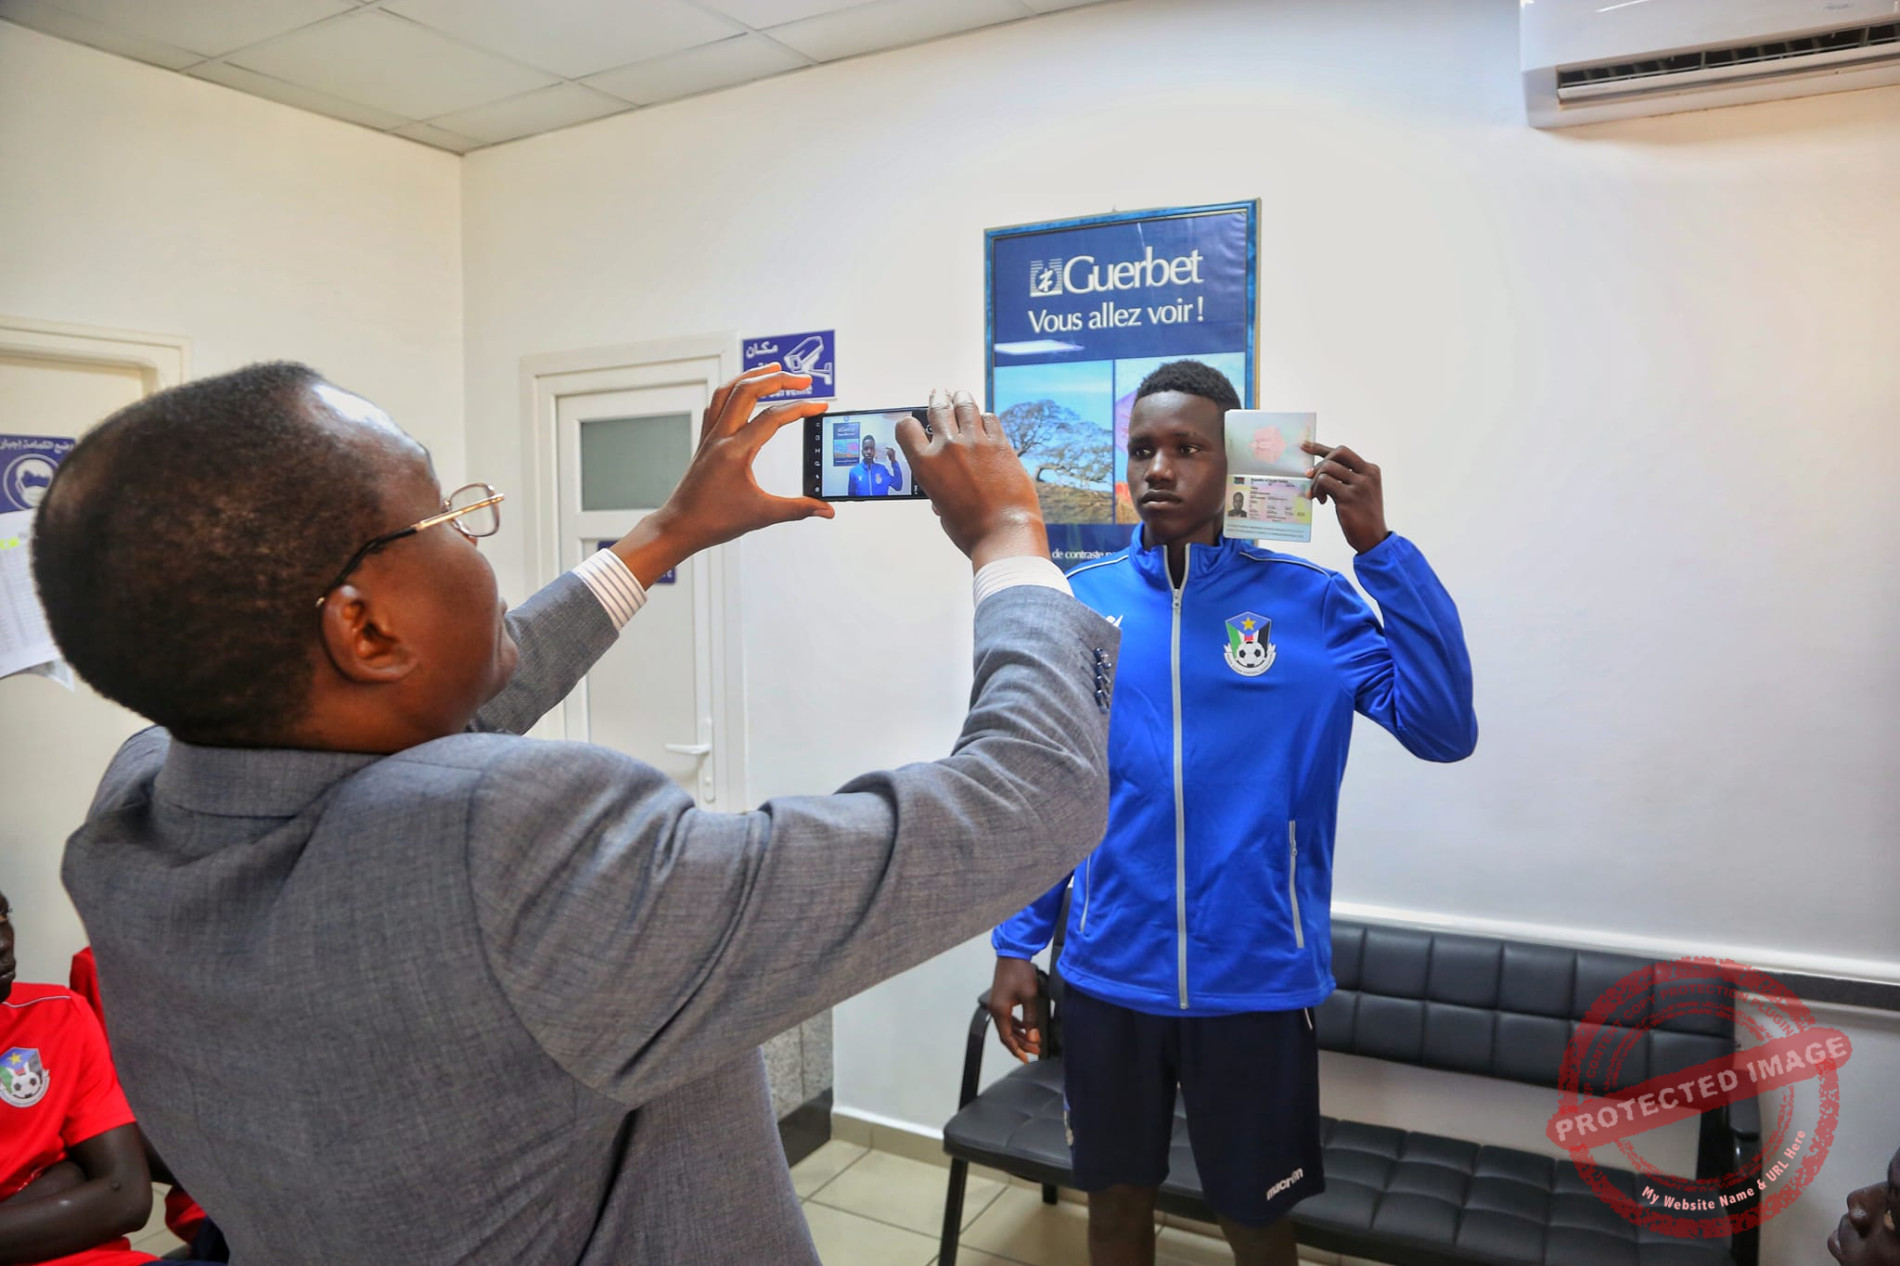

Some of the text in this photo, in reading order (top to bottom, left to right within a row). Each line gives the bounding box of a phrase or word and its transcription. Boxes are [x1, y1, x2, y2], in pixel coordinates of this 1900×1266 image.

[1063, 246, 1204, 294] Guerbet
[1028, 309, 1083, 334] Vous
[1088, 301, 1142, 329] allez
[745, 341, 779, 359] مكان
[1052, 548, 1064, 559] de
